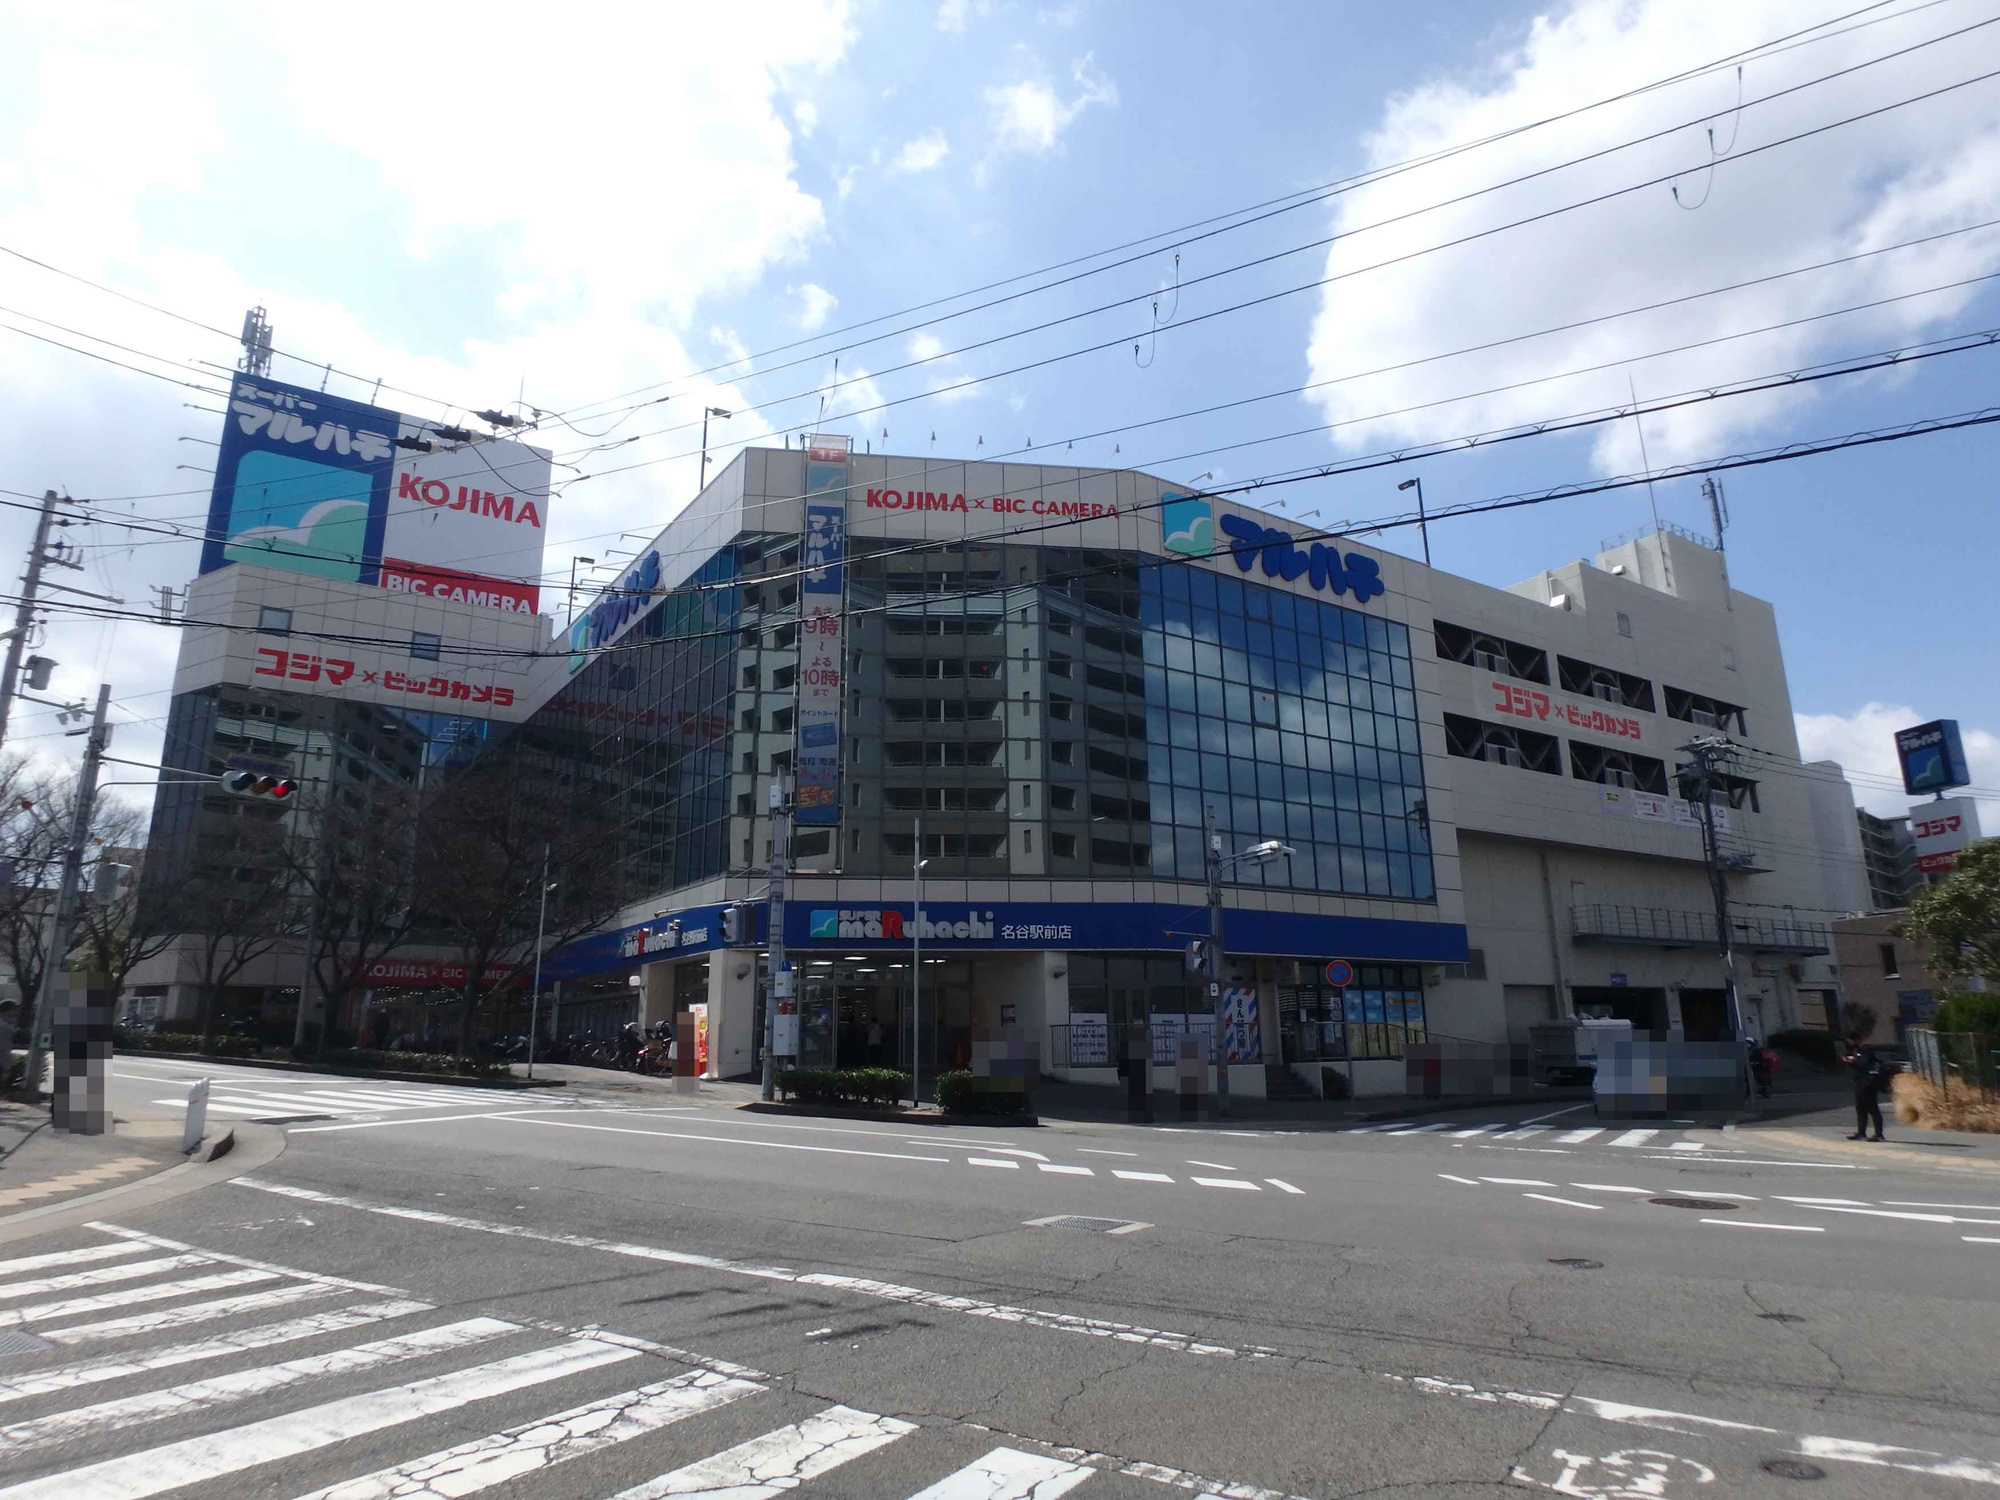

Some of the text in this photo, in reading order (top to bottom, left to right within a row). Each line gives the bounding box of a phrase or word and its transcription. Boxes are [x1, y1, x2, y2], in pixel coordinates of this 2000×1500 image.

[237, 381, 318, 411] スーパー
[232, 400, 392, 462] マルハチ
[398, 472, 541, 528] KOJIMA
[867, 488, 969, 512] KOJIMA
[992, 498, 1026, 514] BIC
[1032, 500, 1120, 519] CAMERA
[1220, 514, 1385, 603] マルハチ
[386, 574, 533, 614] BIC CAMERA
[804, 616, 839, 636] 9時
[811, 656, 832, 667] よる
[801, 669, 840, 687] 10時
[812, 688, 829, 697] まで
[800, 709, 838, 718] ポイントカード
[1914, 815, 1961, 838] コジマ
[838, 910, 882, 921] SUPER
[1001, 924, 1072, 940] 名谷駅前店
